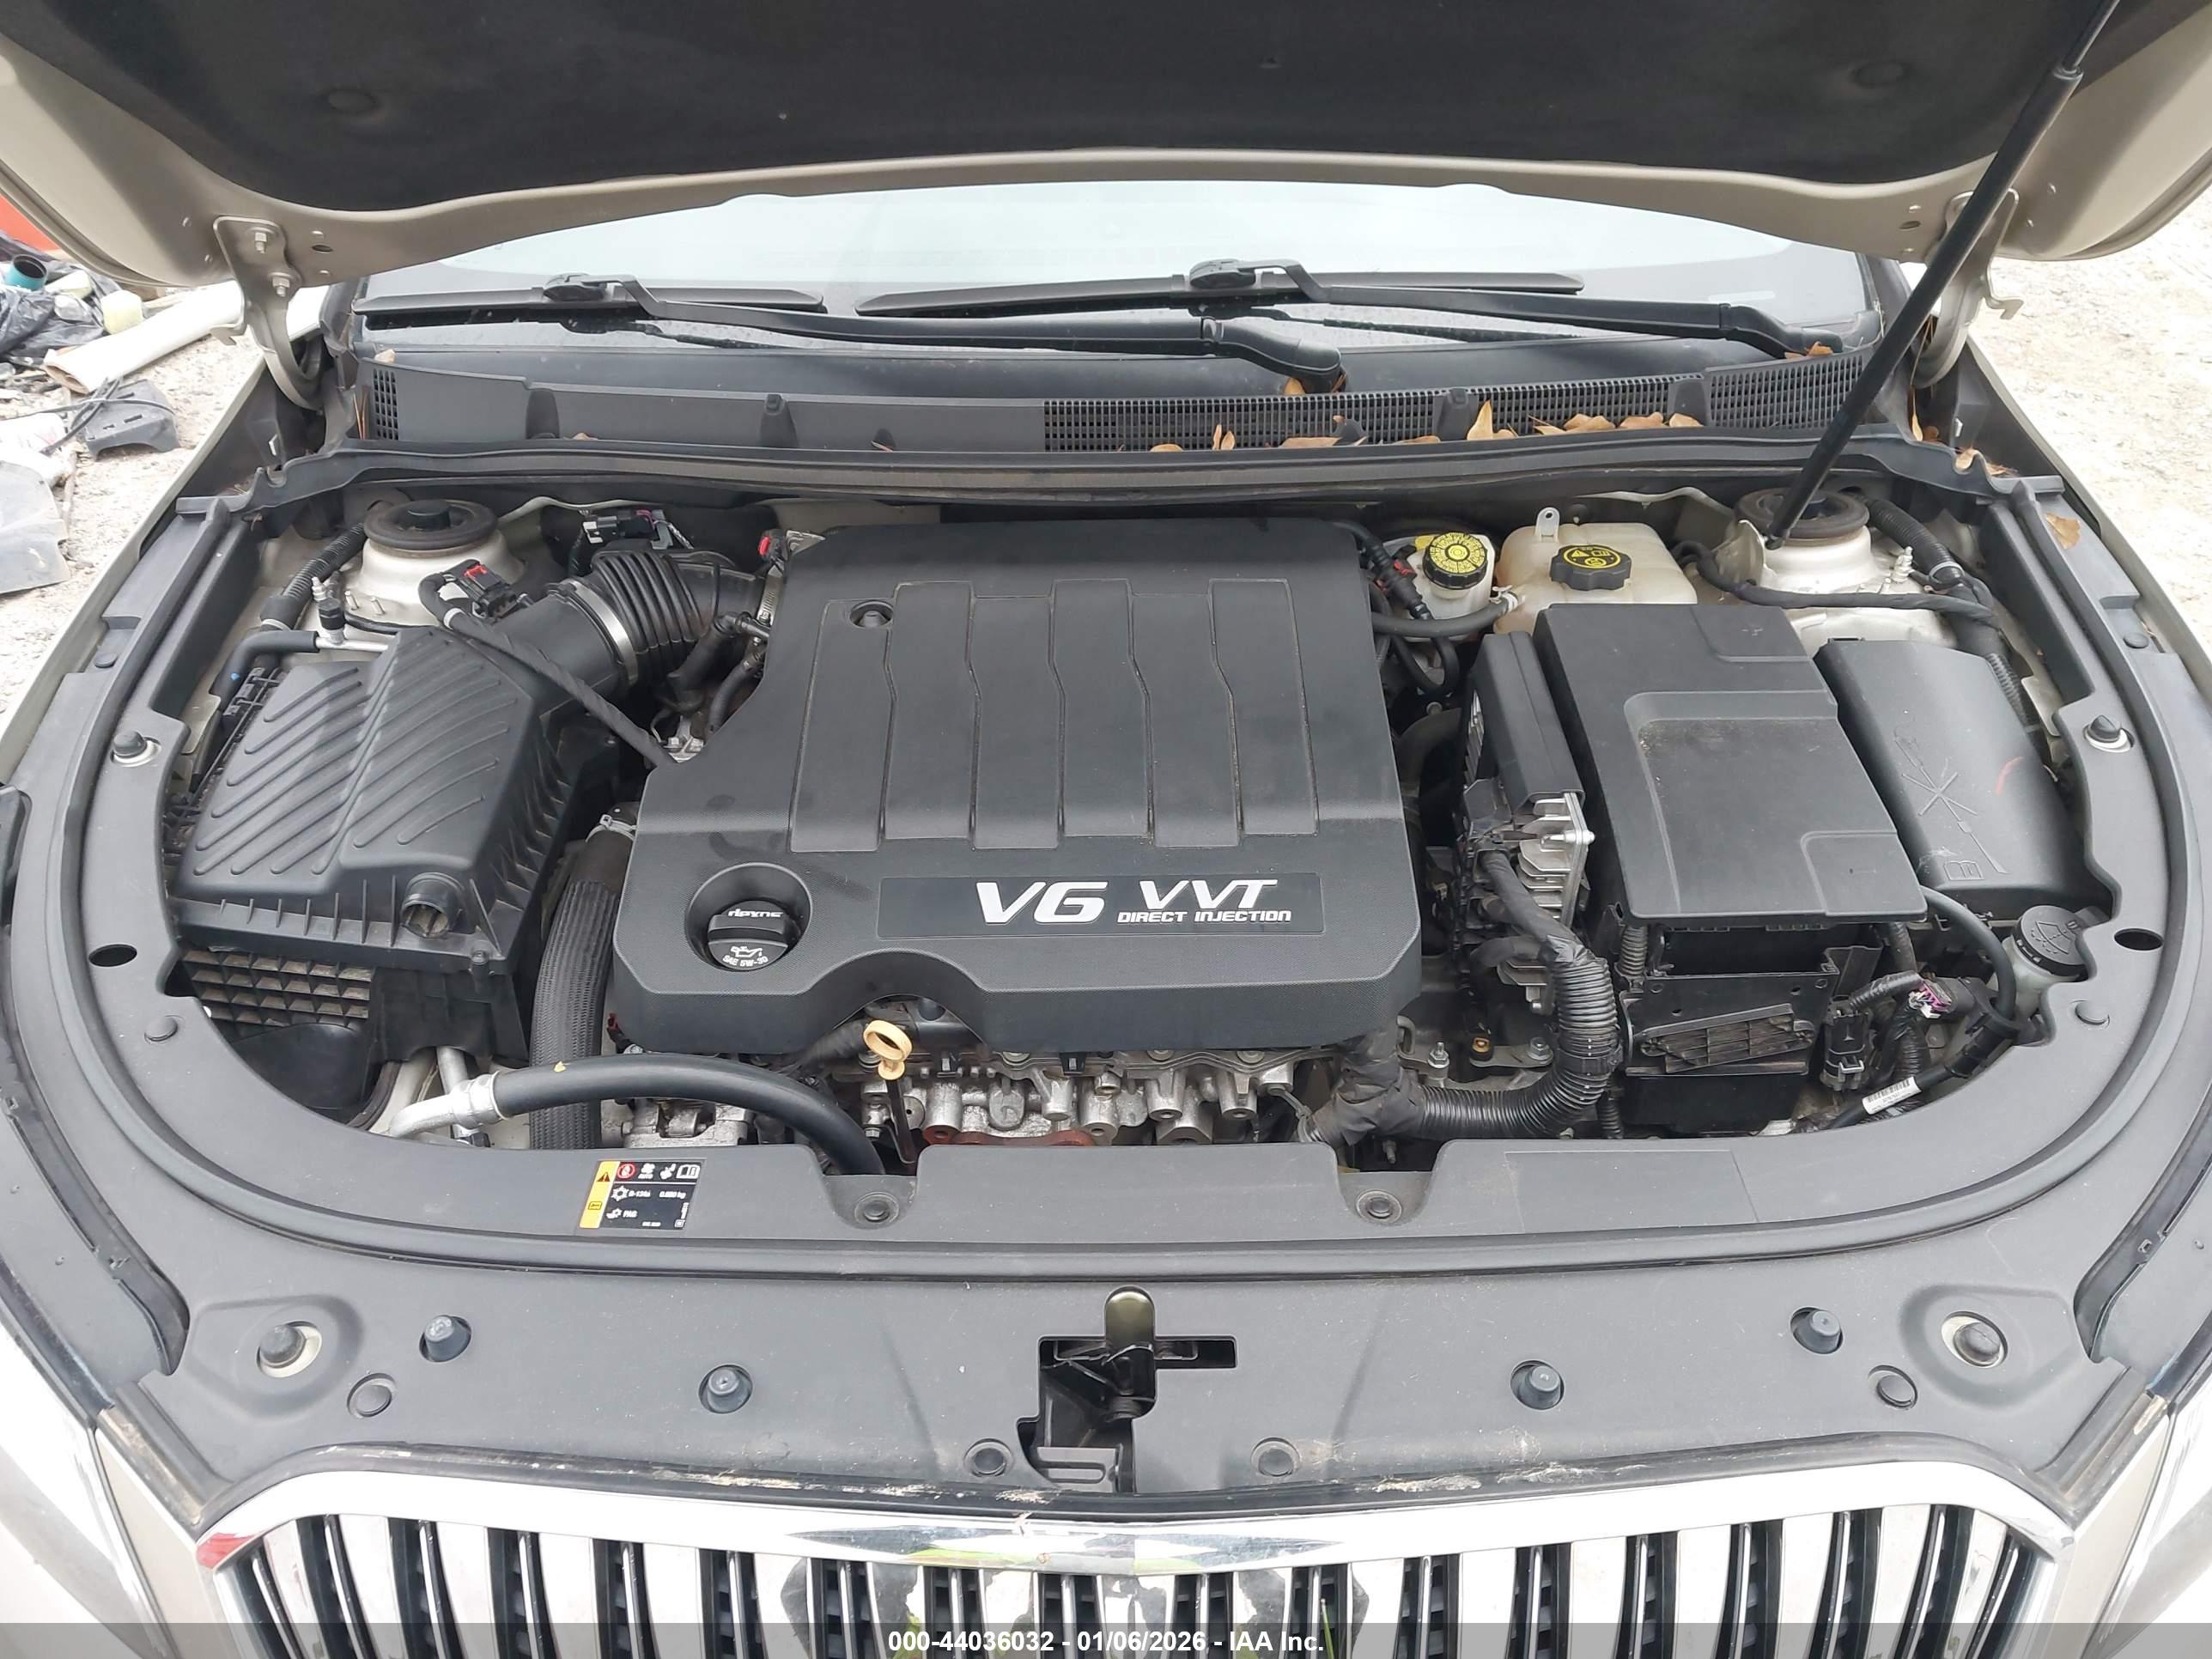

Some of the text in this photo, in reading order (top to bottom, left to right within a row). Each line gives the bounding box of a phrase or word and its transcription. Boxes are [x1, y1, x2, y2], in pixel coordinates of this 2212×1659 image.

[975, 879, 1279, 925] V6 VVT
[1116, 910, 1291, 924] DIRECT INJECTION
[722, 955, 769, 967] SAE 5W-30
